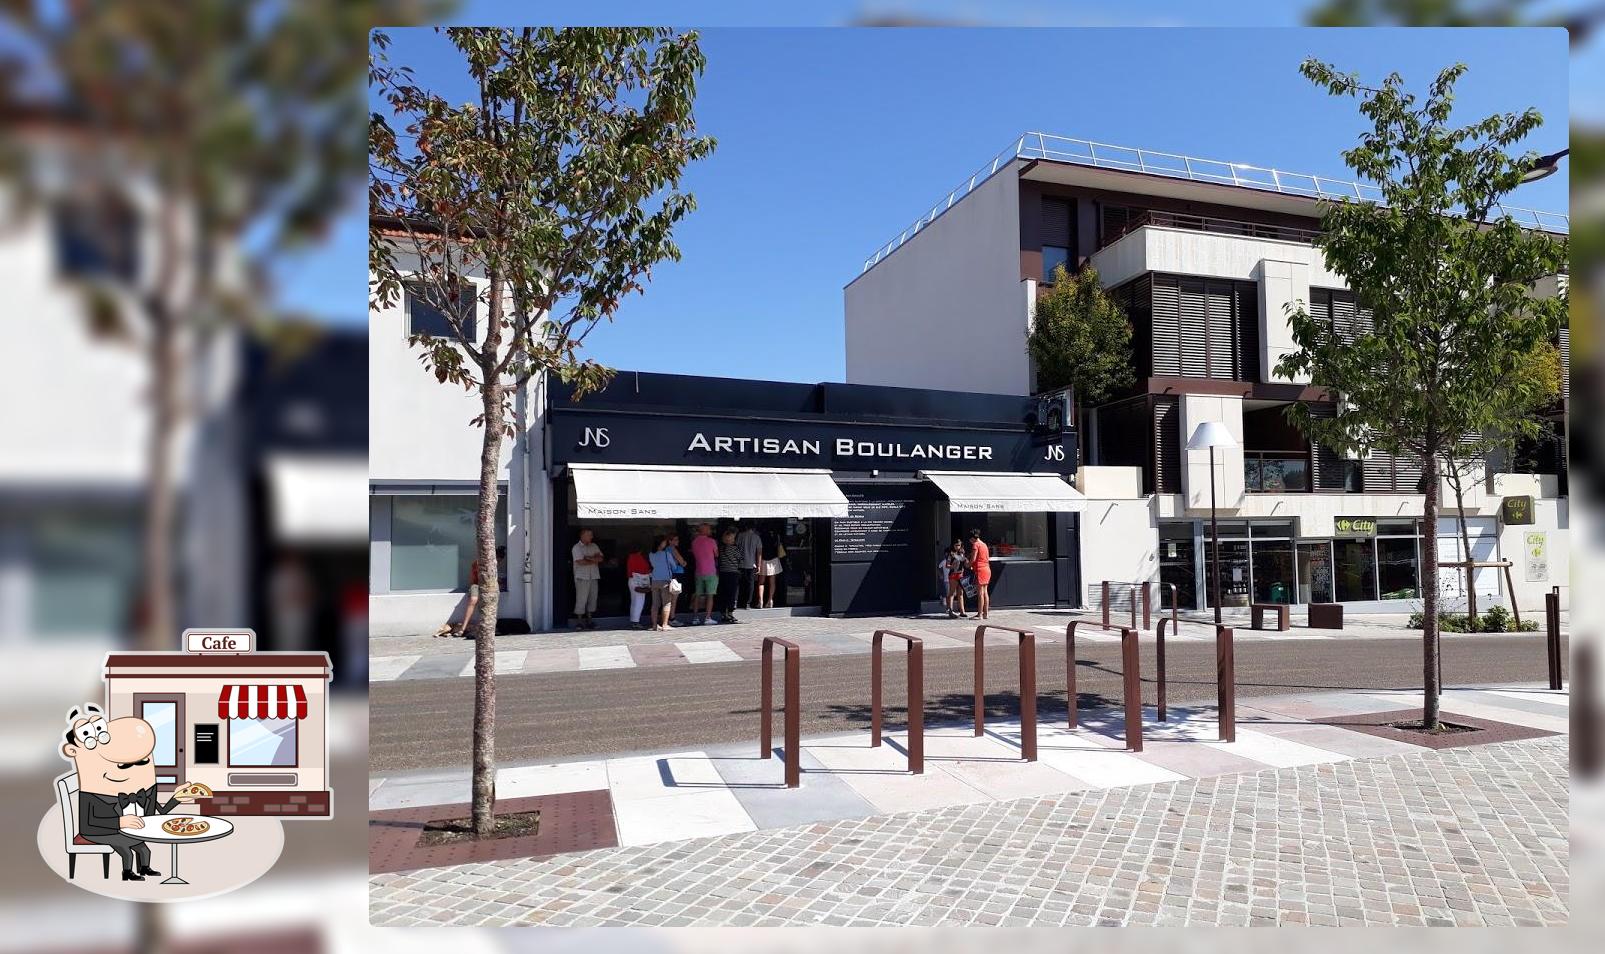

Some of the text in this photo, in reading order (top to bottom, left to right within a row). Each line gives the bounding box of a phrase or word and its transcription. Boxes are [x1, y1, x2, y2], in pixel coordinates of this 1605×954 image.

[1507, 499, 1527, 511] City
[1352, 519, 1375, 535] City
[1526, 534, 1544, 549] City
